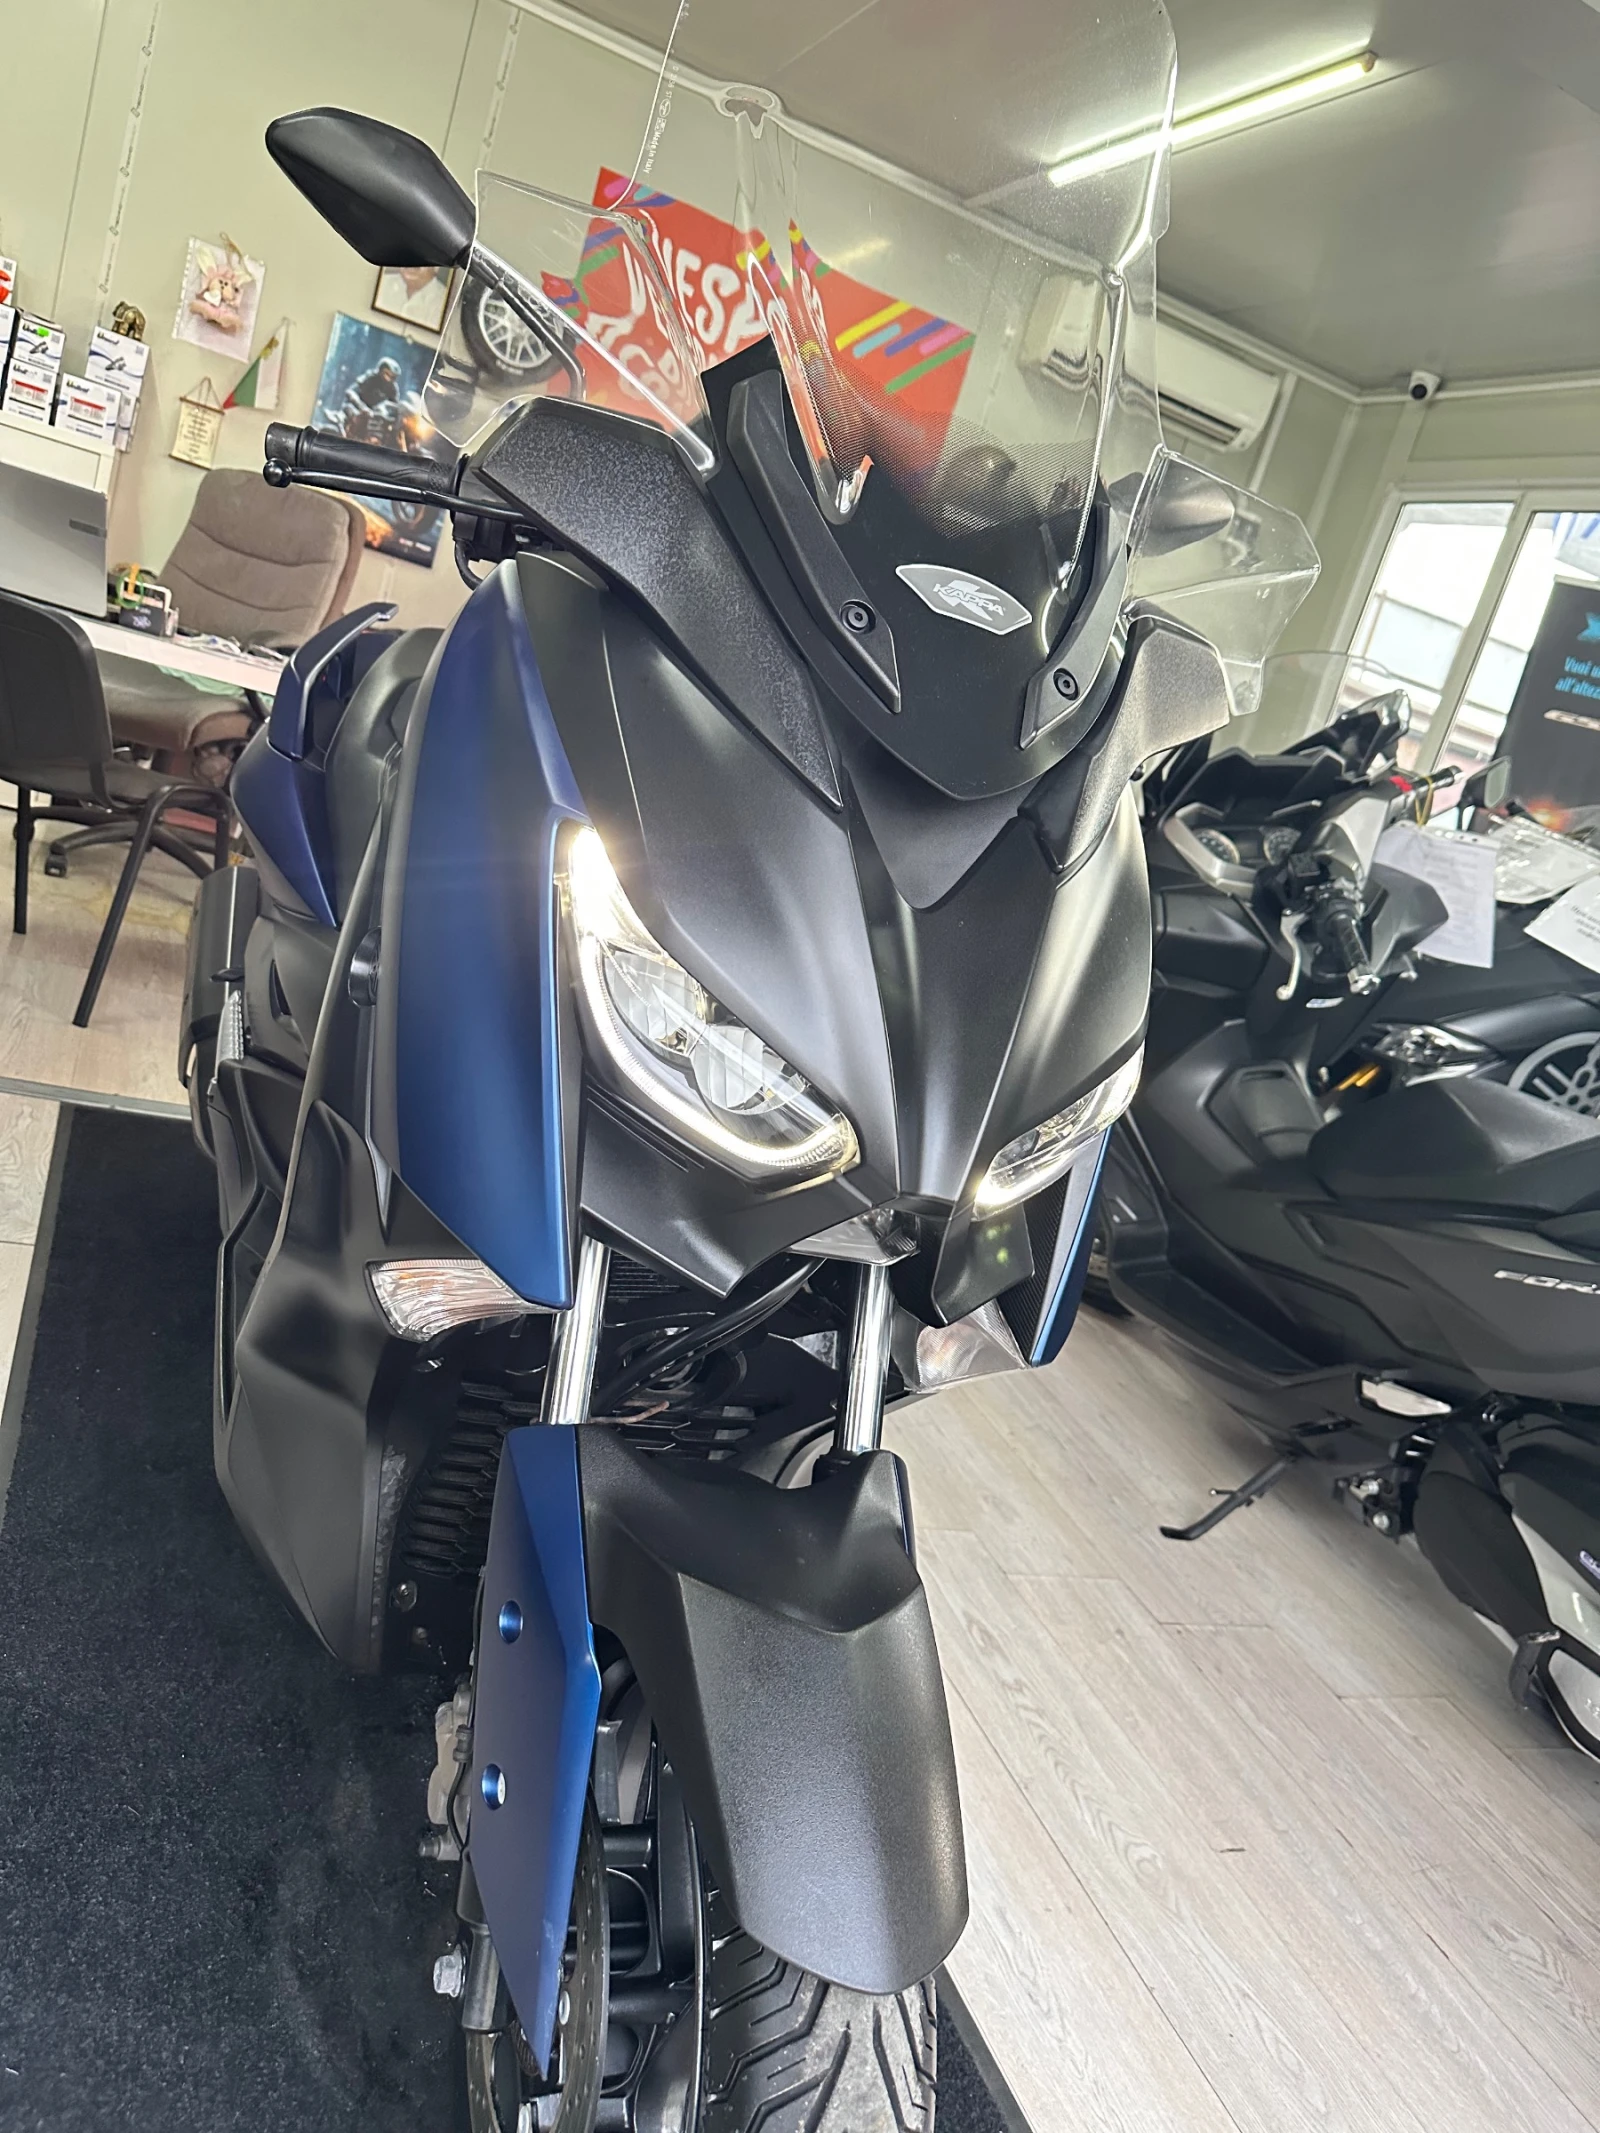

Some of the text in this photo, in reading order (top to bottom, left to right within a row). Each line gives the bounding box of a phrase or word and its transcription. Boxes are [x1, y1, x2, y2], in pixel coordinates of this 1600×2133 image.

[650, 131, 661, 149] Made
[643, 158, 654, 174] Italy
[932, 583, 1005, 617] KAPPA
[1564, 655, 1592, 676] Vuoi
